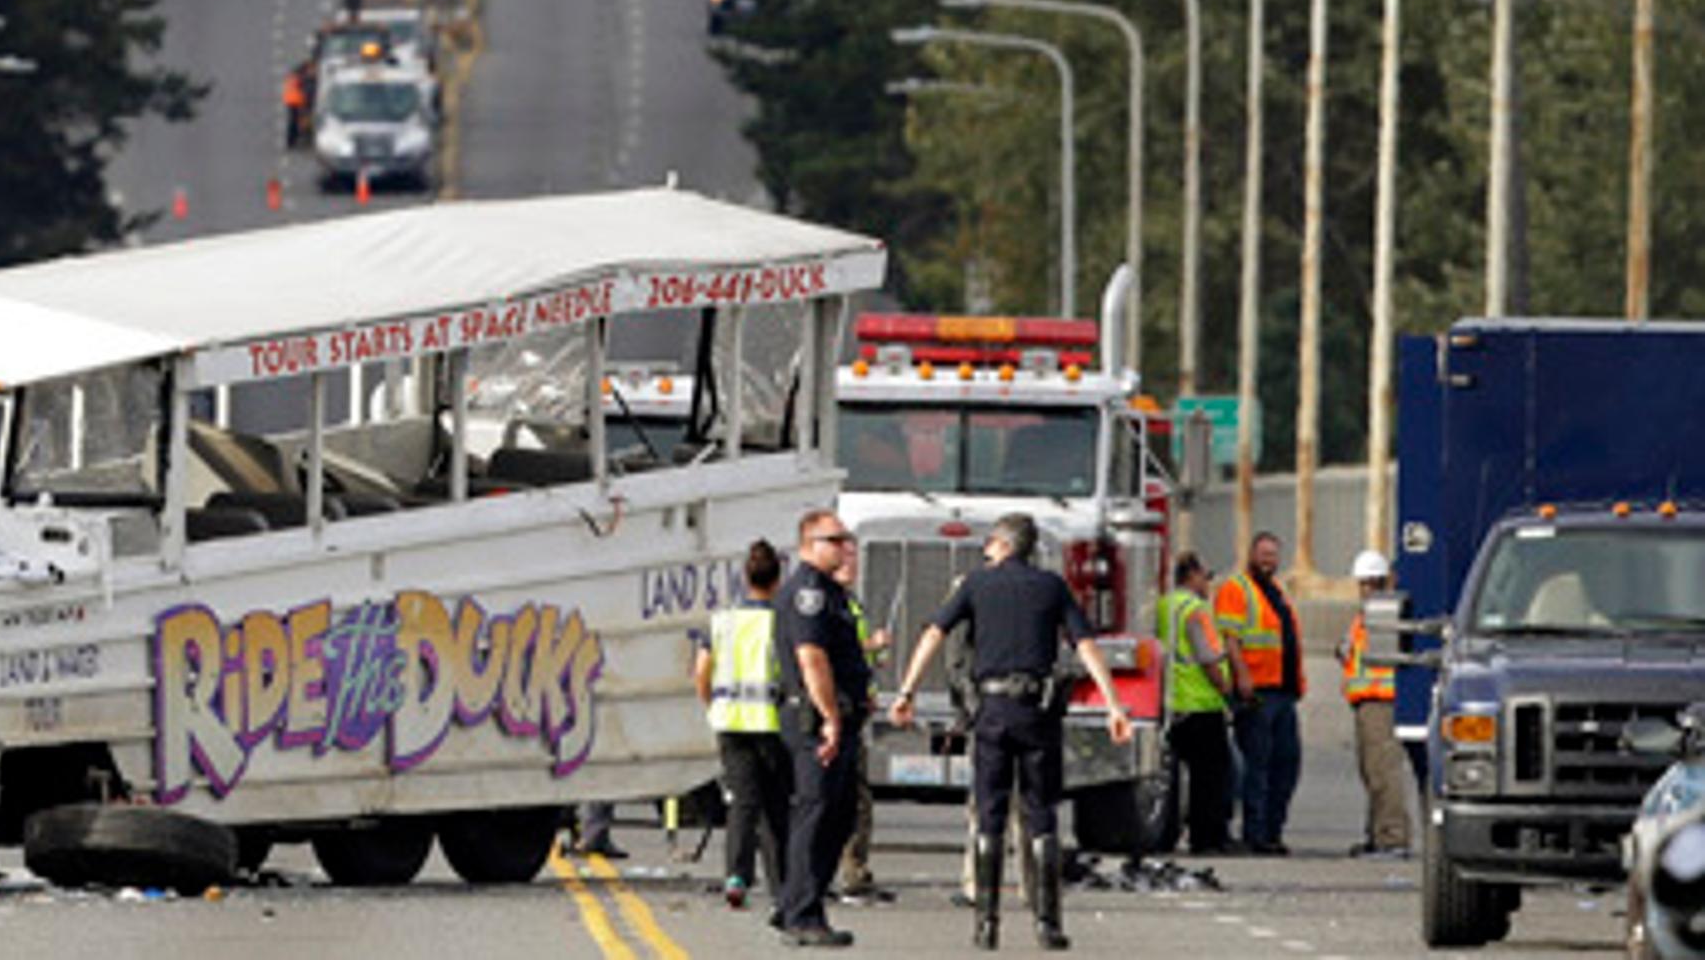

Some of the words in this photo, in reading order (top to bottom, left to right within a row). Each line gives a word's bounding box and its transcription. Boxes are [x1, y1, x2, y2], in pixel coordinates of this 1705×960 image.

[249, 337, 318, 376] TOUR
[329, 324, 413, 363] STARTS
[422, 316, 451, 348] AT
[460, 296, 527, 342] SPACE
[534, 278, 614, 327] NEEDLE
[647, 263, 827, 308] 206-441-DUCK
[641, 563, 697, 620] LAND
[390, 589, 604, 778] DUCKS
